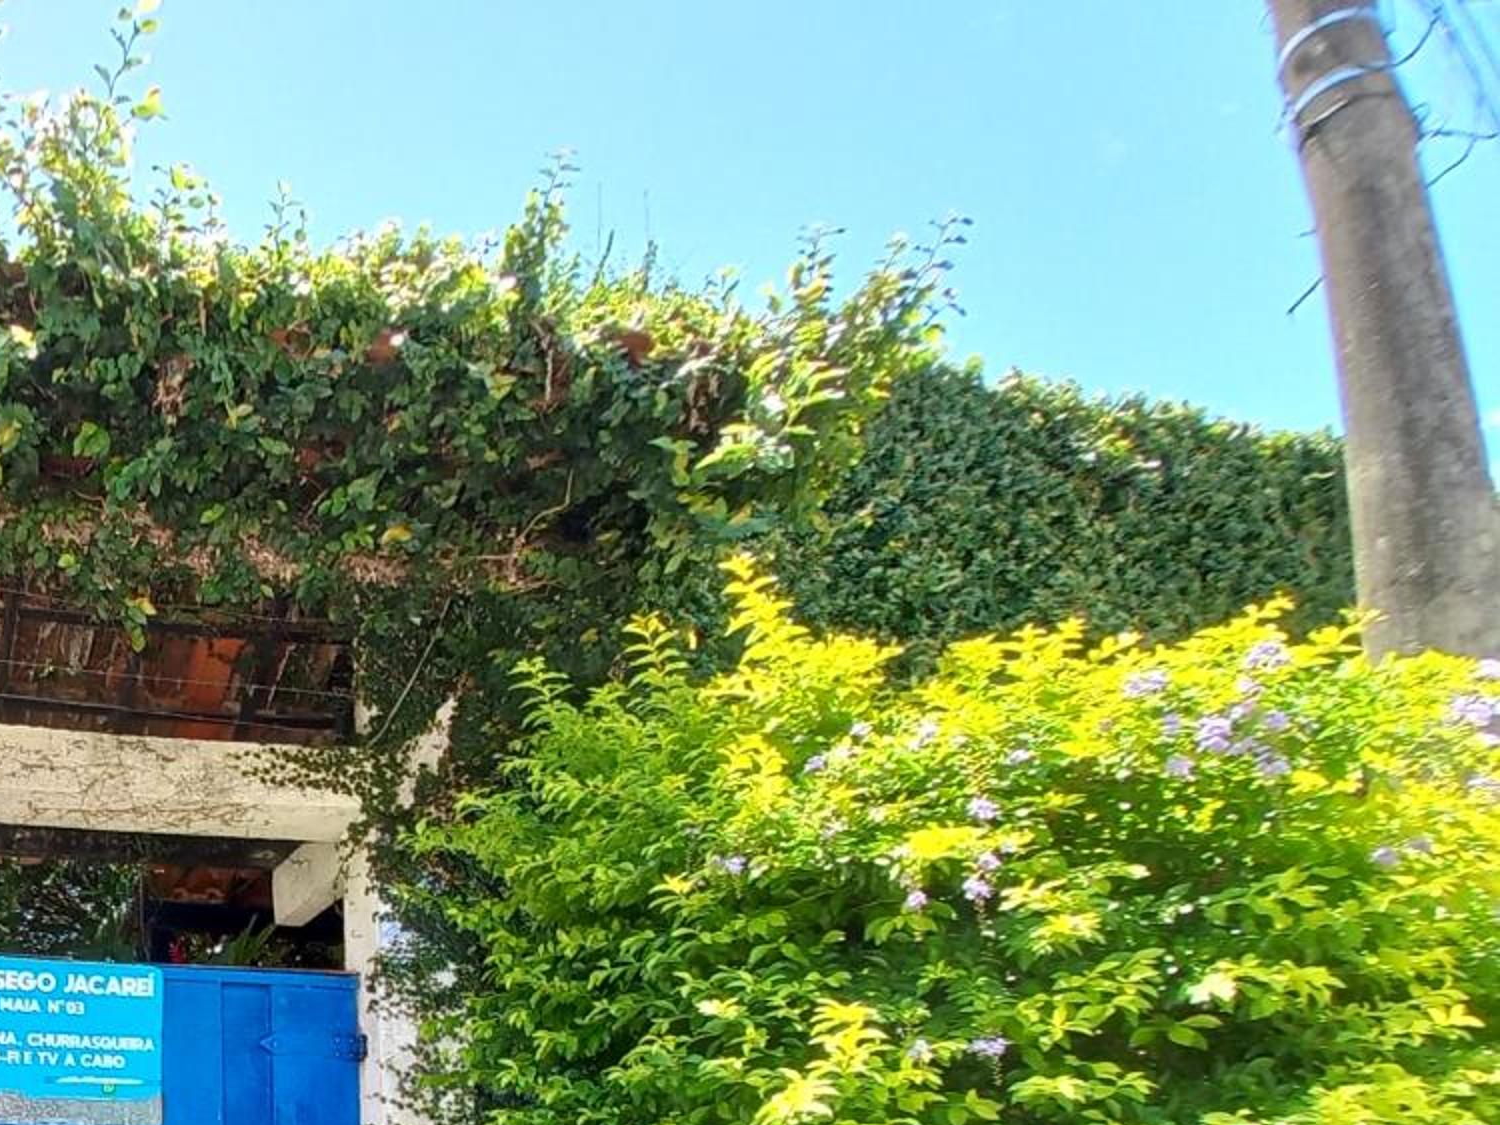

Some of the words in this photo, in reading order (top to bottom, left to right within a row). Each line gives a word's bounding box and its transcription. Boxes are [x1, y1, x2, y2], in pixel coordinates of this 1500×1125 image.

[63, 973, 156, 997] JACAREÍ
[0, 998, 41, 1013] MAIA
[27, 1033, 155, 1052] CHURRASQUEIRA
[23, 1052, 33, 1065] E
[37, 1053, 60, 1067] TV
[64, 1054, 76, 1067] A
[80, 1054, 125, 1069] CABO
